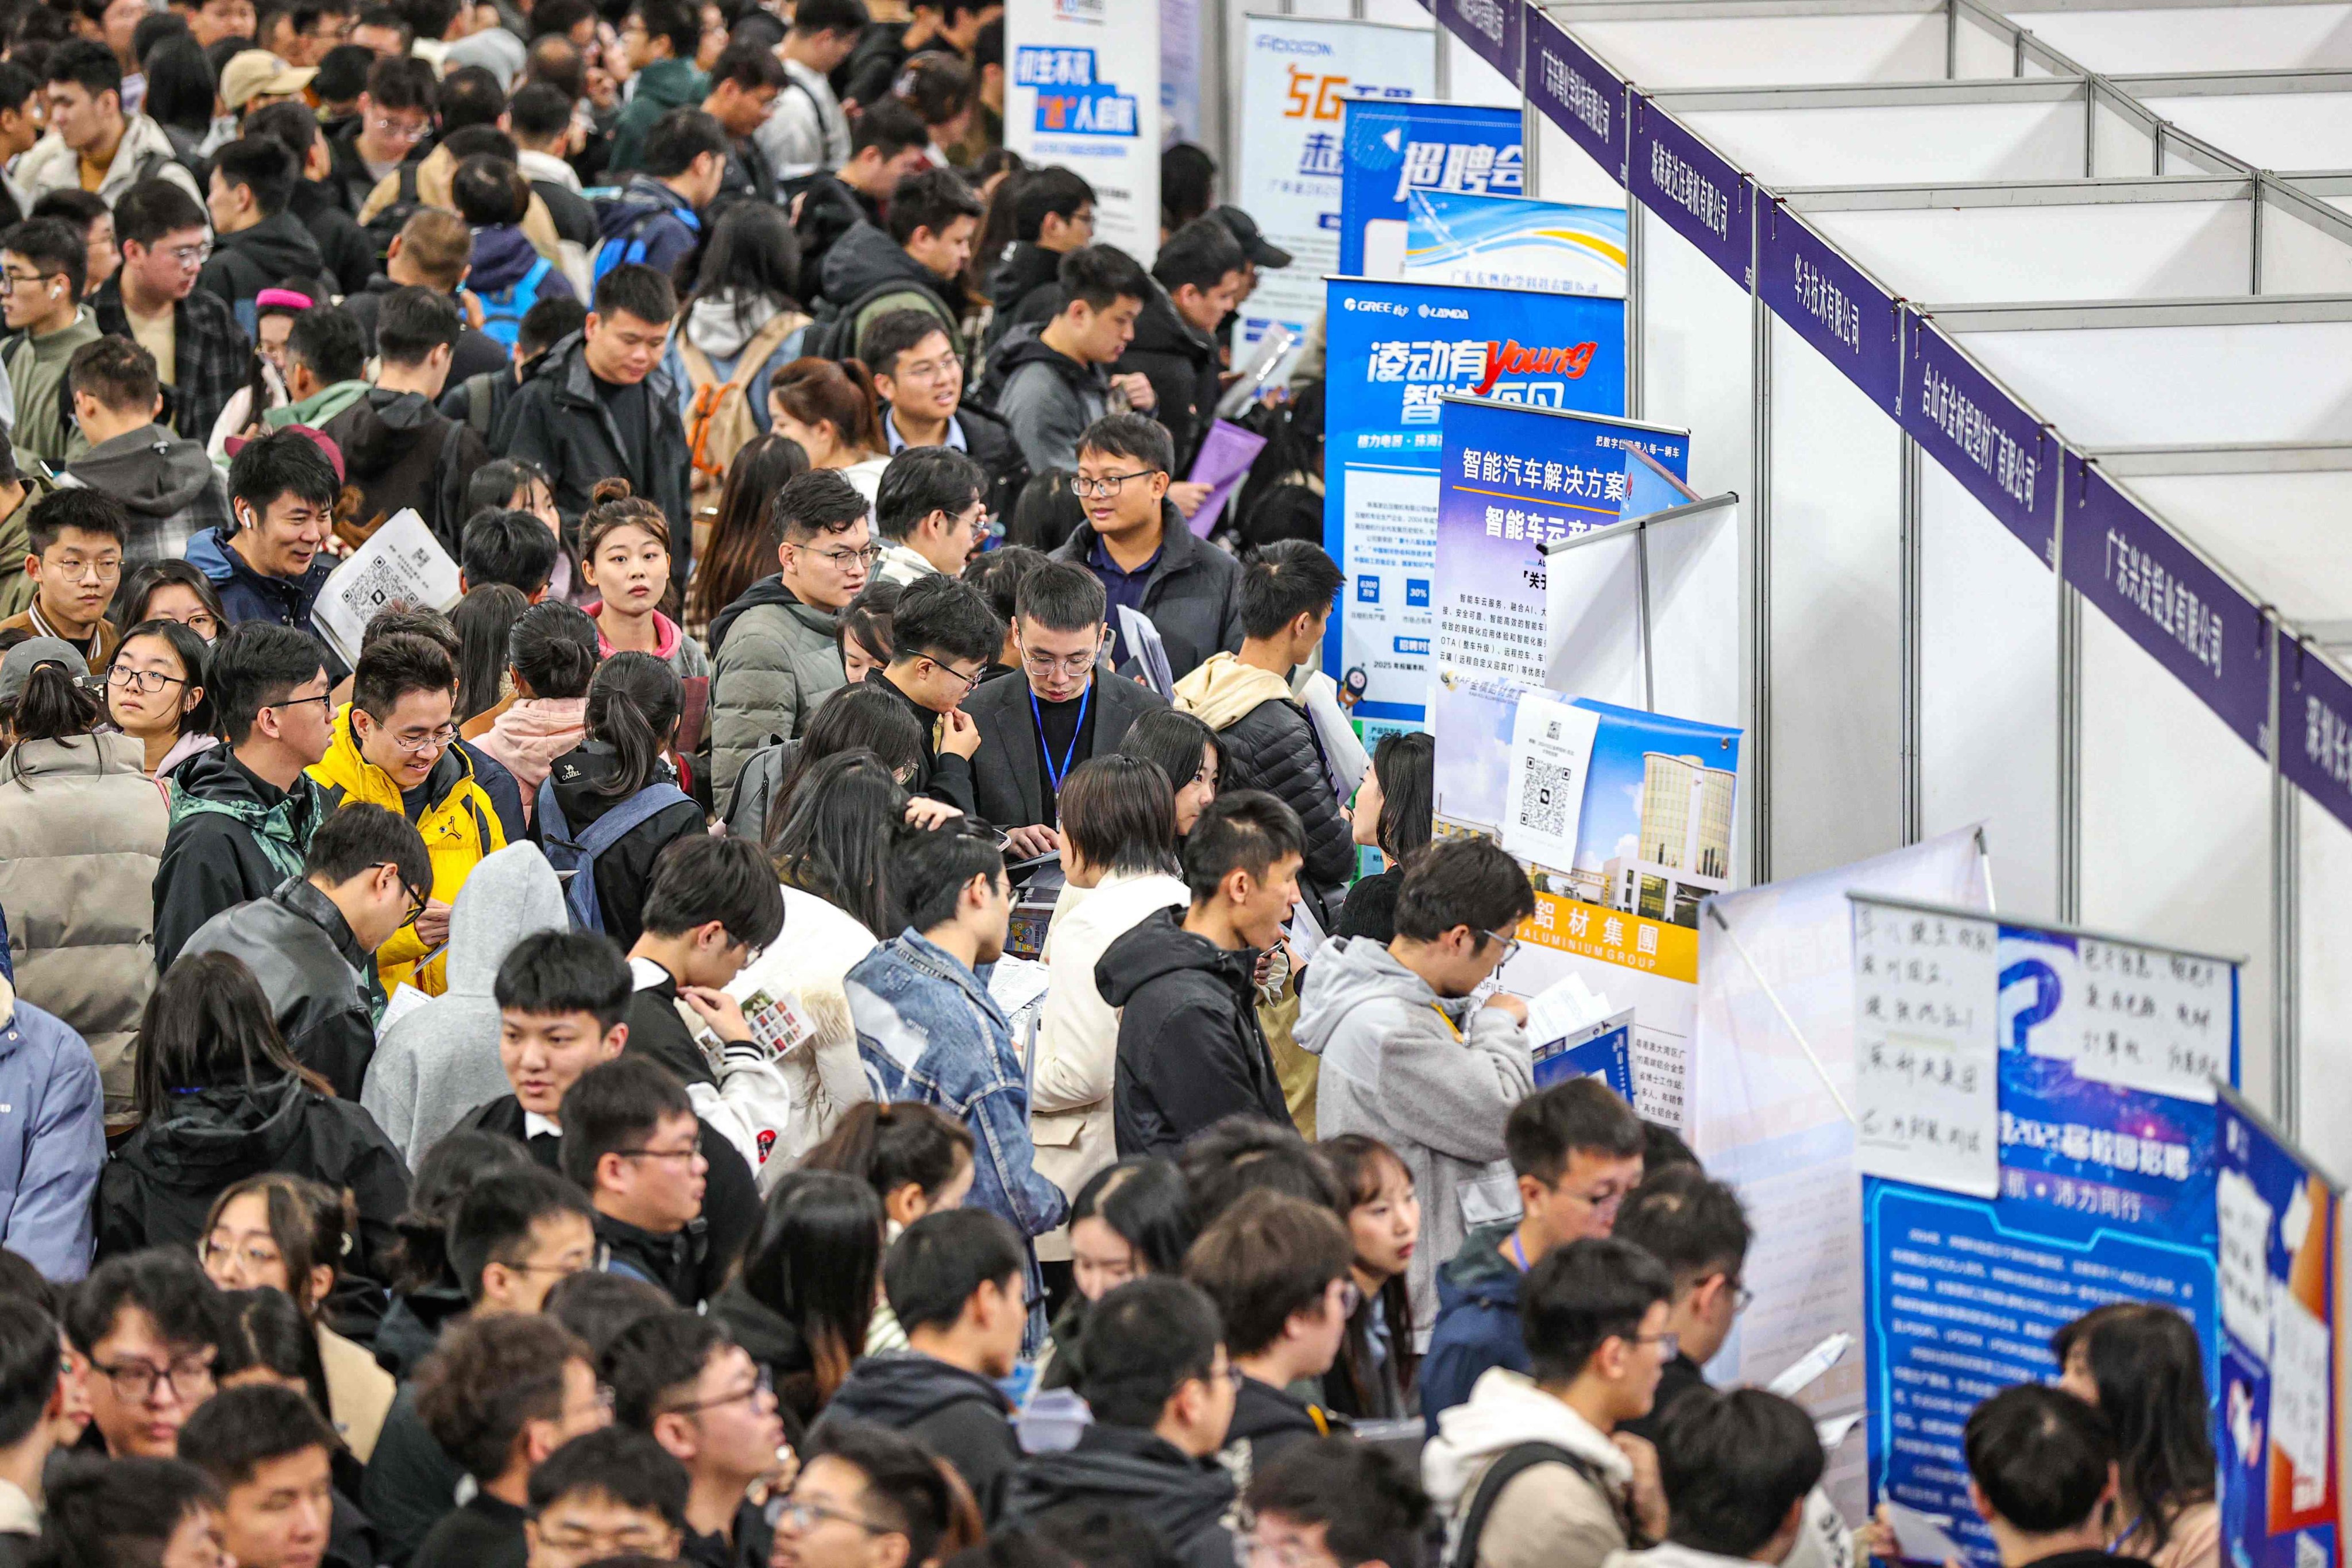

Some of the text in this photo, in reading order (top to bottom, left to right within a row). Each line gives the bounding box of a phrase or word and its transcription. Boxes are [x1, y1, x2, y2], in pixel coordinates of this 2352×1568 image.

[1651, 139, 1728, 242] 珠海凌达压缩机有限公司
[1357, 300, 1393, 314] GREE
[1794, 253, 1859, 354] 华为技术有限公司
[1922, 362, 2035, 512] 台山市金桥铝型材厂有限公司
[1463, 447, 1624, 503] 智能汽车解决方案
[1409, 588, 1427, 598] 30%
[1442, 606, 1546, 632] 接、安全可靠、智能高效的智能车
[1399, 639, 1430, 652] 招聘对
[1440, 637, 1546, 663] OTA（整车升级）、远程控车、车
[562, 771, 581, 781] CAMEL
[1534, 898, 1658, 956] 鋁材集團
[1523, 927, 1656, 969] ALUMINIUM GROUP
